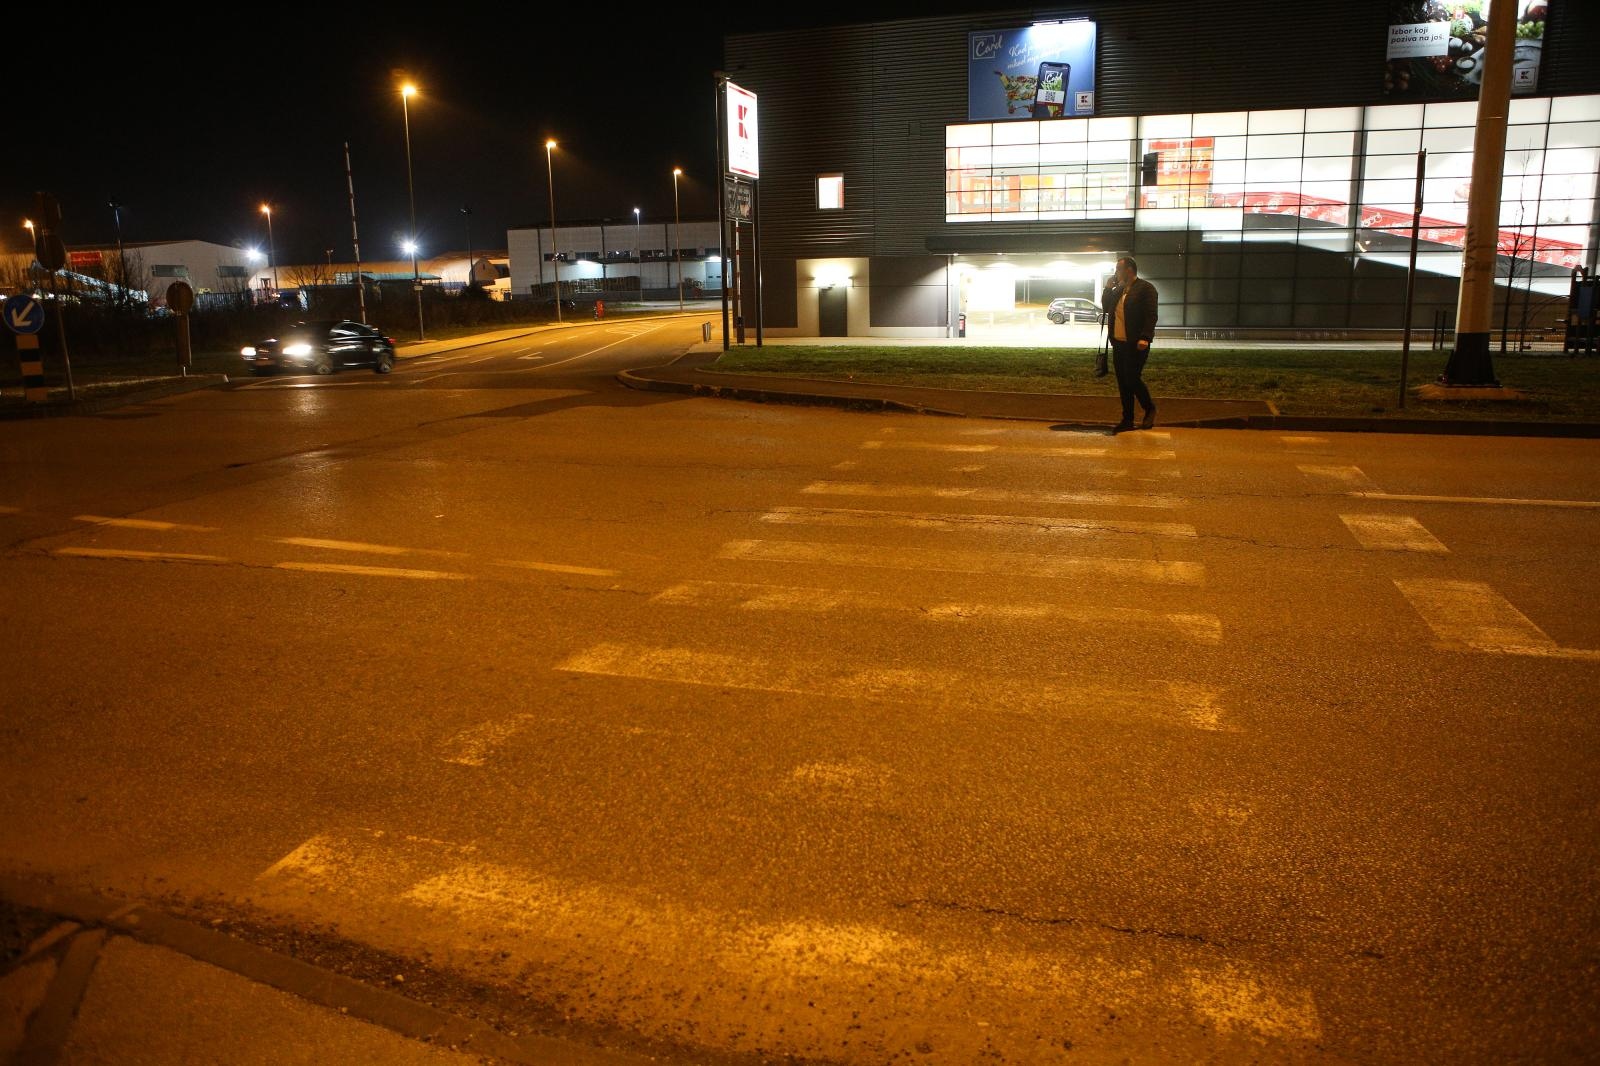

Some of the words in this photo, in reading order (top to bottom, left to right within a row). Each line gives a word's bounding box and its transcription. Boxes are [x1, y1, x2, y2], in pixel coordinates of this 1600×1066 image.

[1414, 26, 1429, 35] koji
[975, 35, 1003, 57] Card
[1390, 35, 1417, 44] poziva
[738, 104, 748, 139] K
